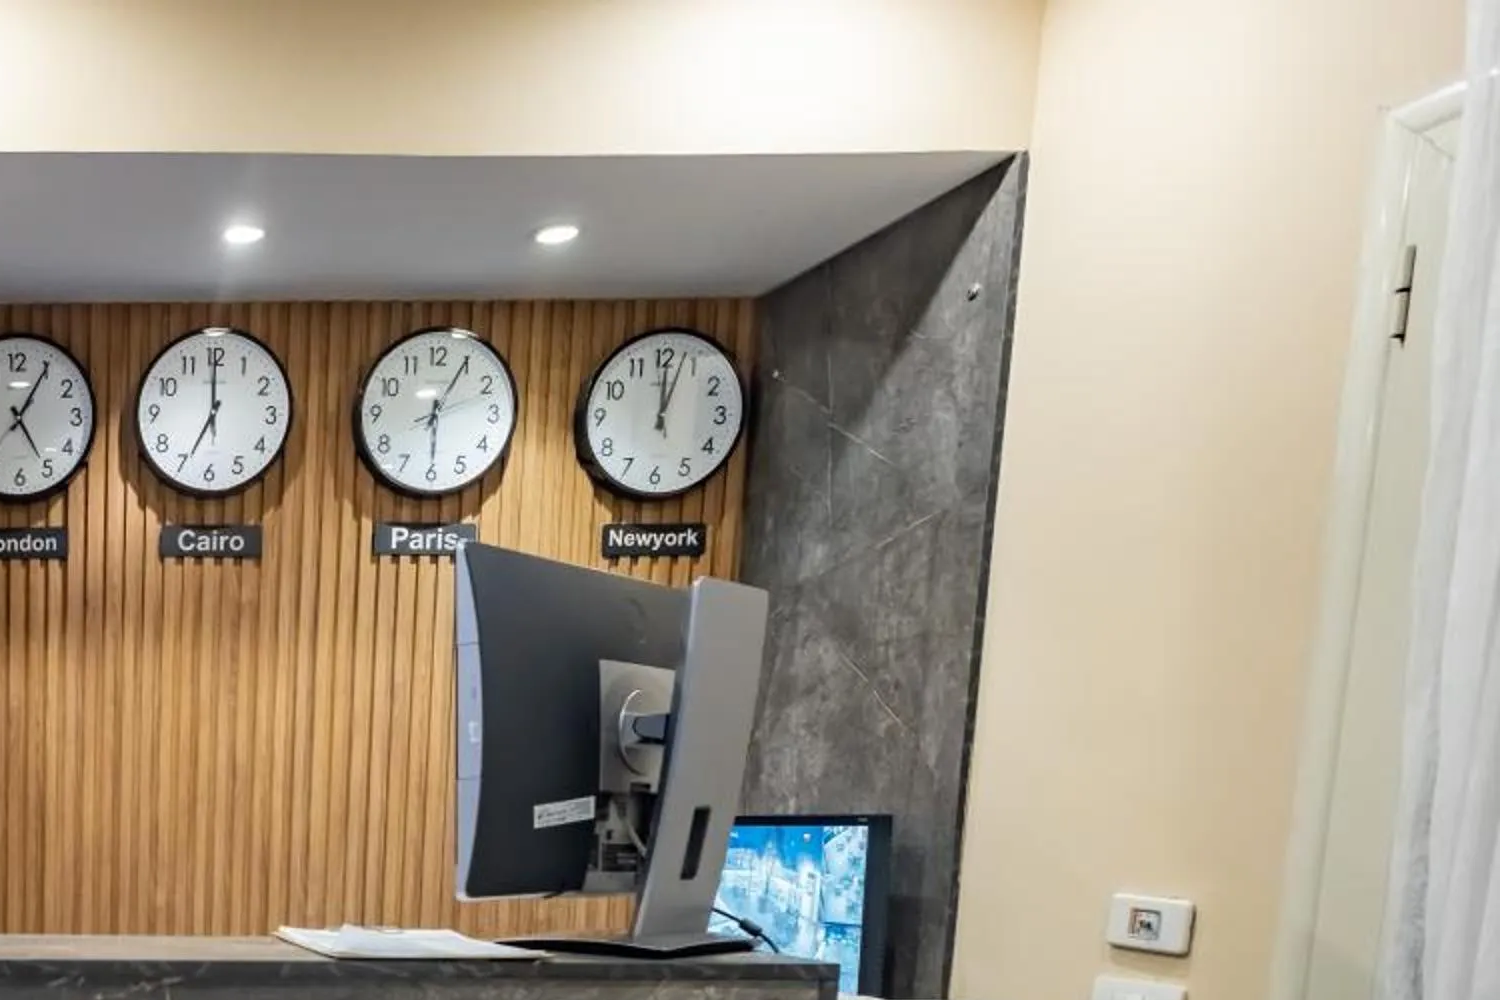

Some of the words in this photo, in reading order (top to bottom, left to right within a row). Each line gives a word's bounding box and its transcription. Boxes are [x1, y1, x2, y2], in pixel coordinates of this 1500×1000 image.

[7, 352, 27, 372] 12
[404, 356, 418, 375] 11
[429, 346, 447, 366] 12
[656, 348, 674, 368] 12
[182, 356, 195, 376] 11
[241, 356, 247, 376] 1
[630, 358, 644, 378] 11
[690, 357, 697, 376] 1
[61, 379, 73, 398] 2
[159, 377, 177, 397] 10
[258, 376, 270, 396] 2
[381, 377, 399, 397] 10
[481, 376, 492, 395] 2
[606, 380, 625, 401] 10
[708, 376, 720, 396] 2
[71, 408, 83, 426] 3
[148, 404, 160, 424] 9
[265, 406, 277, 425] 3
[370, 404, 382, 423] 9
[488, 404, 499, 424] 3
[594, 408, 606, 427] 9
[714, 406, 727, 425] 3
[61, 438, 73, 456] 4
[156, 434, 168, 453] 8
[254, 437, 265, 455] 4
[378, 434, 390, 454] 8
[477, 436, 488, 452] 4
[602, 438, 613, 457] 8
[702, 437, 714, 454] 4
[42, 459, 53, 478] 5
[178, 454, 188, 473] 7
[203, 464, 215, 481] 6
[232, 456, 244, 474] 5
[399, 454, 410, 472] 7
[425, 464, 436, 481] 6
[454, 456, 466, 474] 5
[624, 457, 634, 480] 7
[678, 457, 691, 476] 5
[14, 468, 25, 486] 6
[650, 466, 661, 485] 6
[177, 530, 245, 551] Cairo
[391, 527, 458, 551] Paris
[608, 529, 698, 552] Newyork
